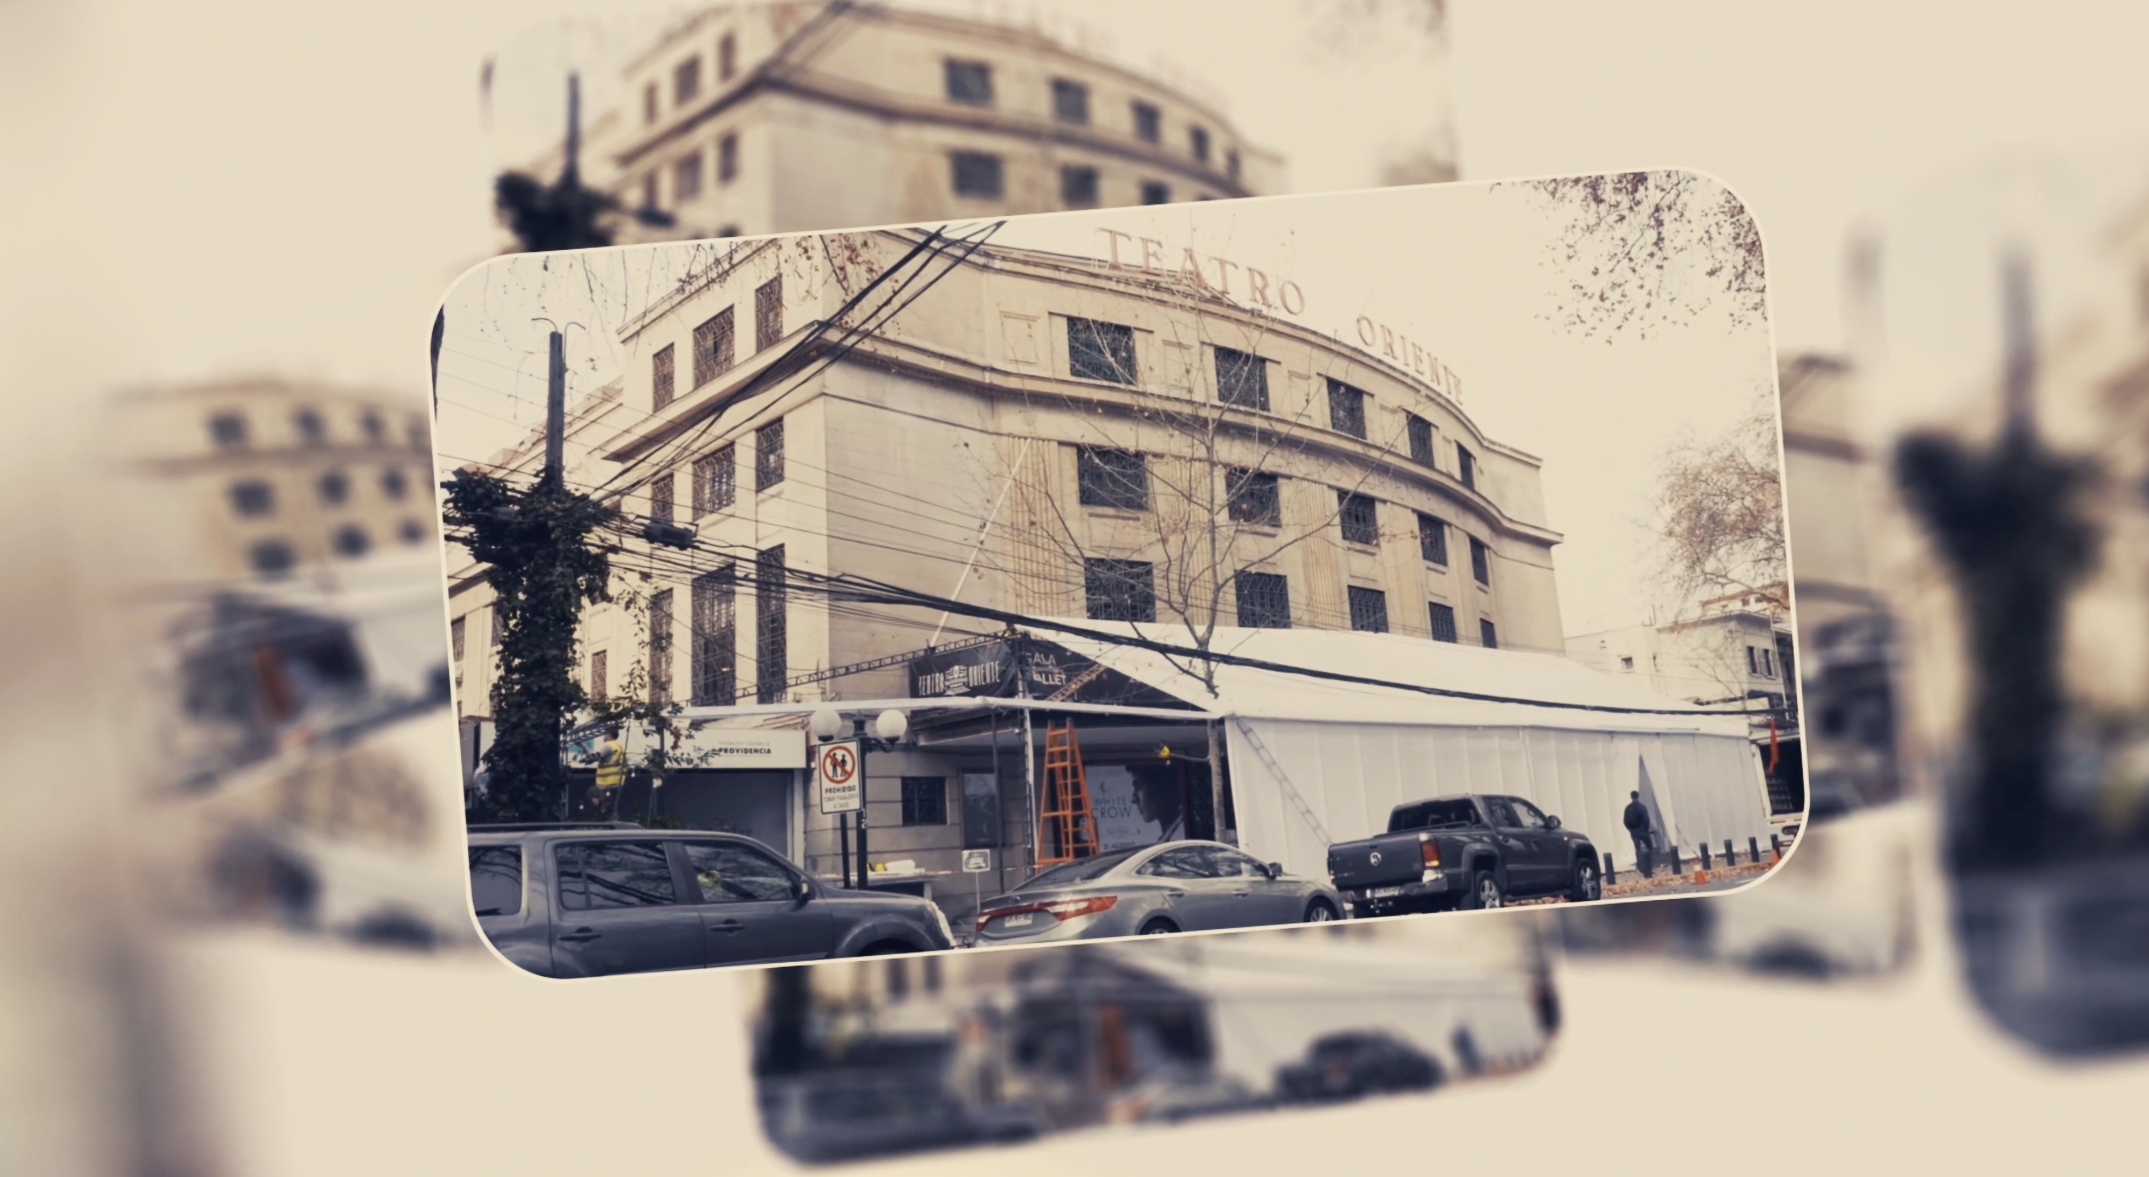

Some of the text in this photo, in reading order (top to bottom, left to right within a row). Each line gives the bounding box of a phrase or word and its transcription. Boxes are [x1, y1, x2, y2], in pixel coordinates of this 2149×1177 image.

[1098, 228, 1464, 406] TEATRO ORIENTE
[1025, 652, 1057, 666] GALA
[918, 660, 1001, 696] TEATRO ORIENTE
[1031, 670, 1067, 686] ALLET
[825, 785, 857, 794] PROHIBIDO
[1093, 796, 1127, 806] WHITE
[1092, 806, 1132, 819] CROW
